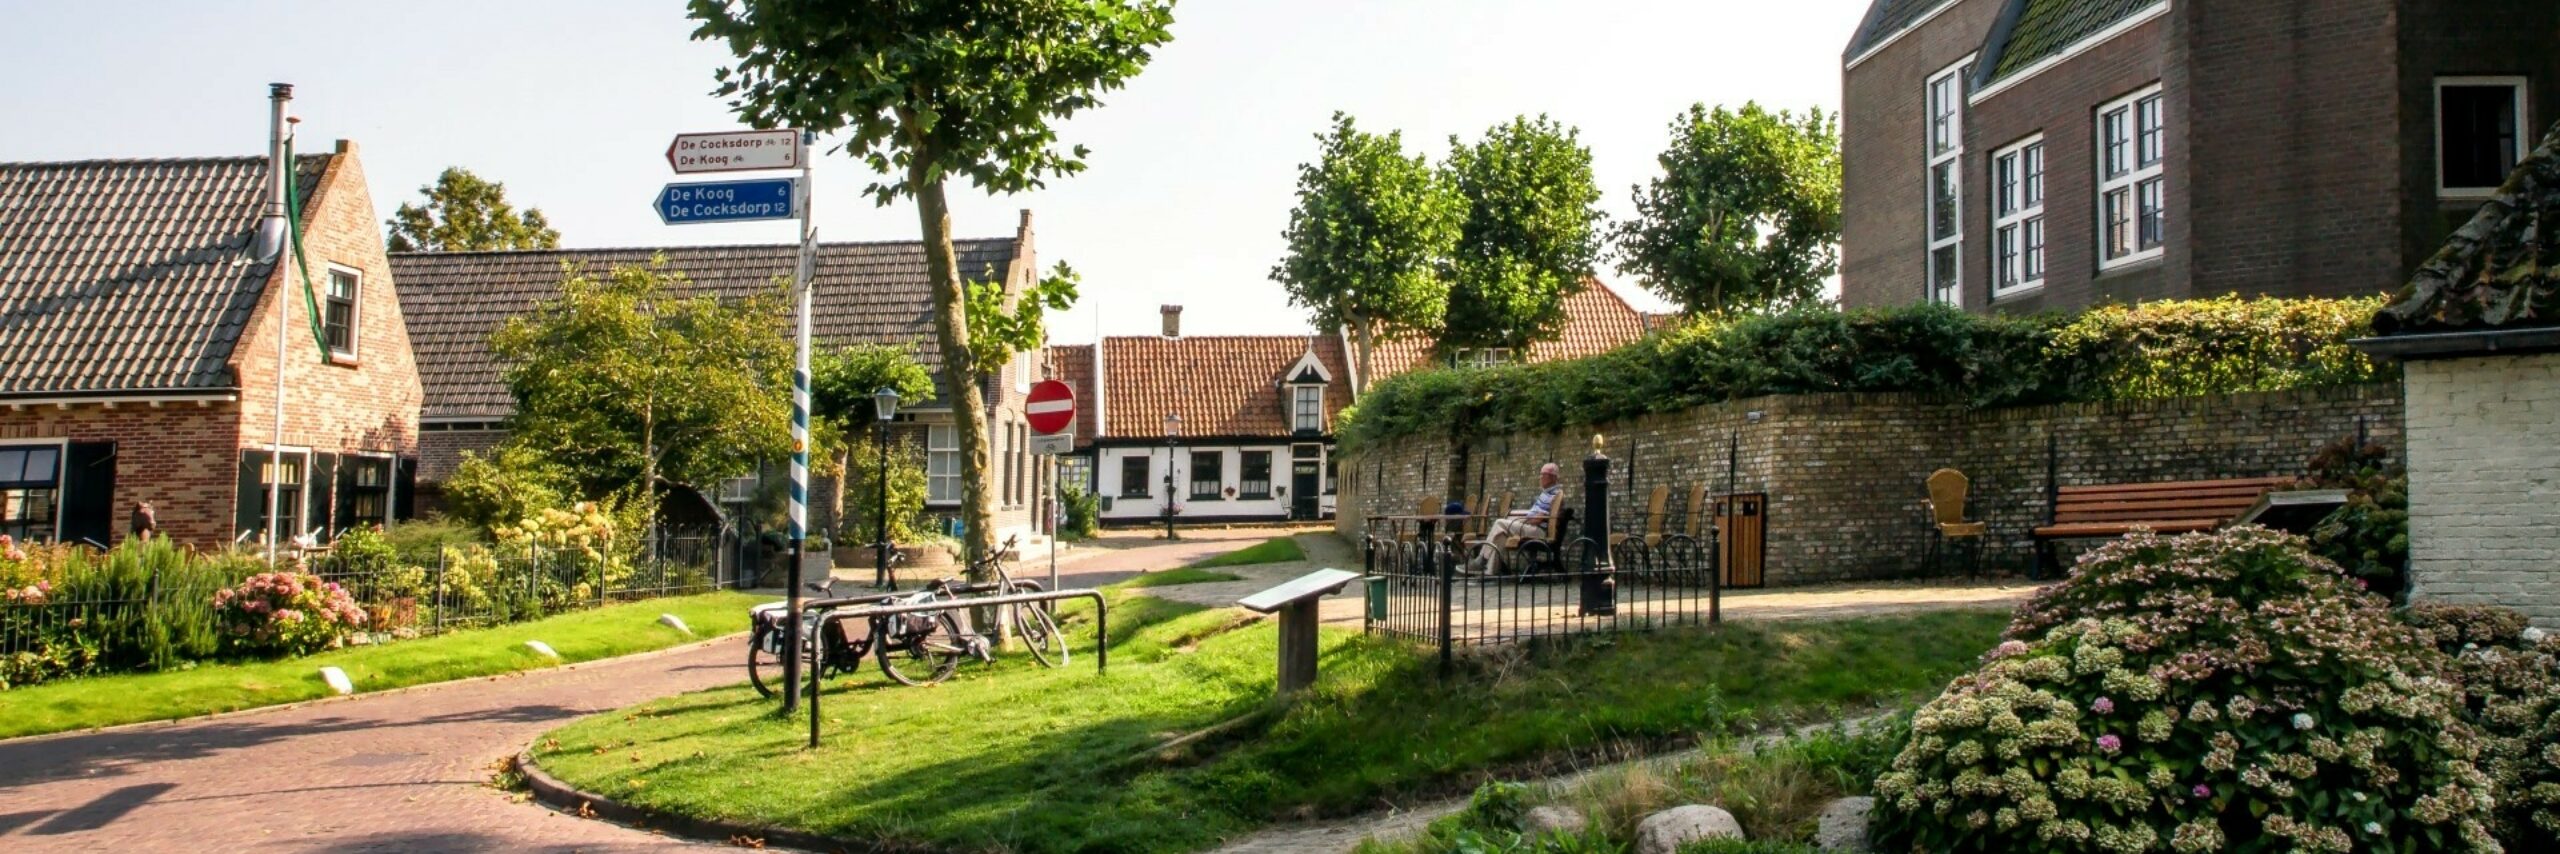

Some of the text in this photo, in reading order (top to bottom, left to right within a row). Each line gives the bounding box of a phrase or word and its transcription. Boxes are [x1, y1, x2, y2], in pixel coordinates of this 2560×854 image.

[681, 138, 791, 150] De Cocksdorp 12
[680, 153, 790, 166] De Koog 6
[671, 186, 786, 201] De Koog 6
[670, 201, 786, 217] De Cocksdorp 12
